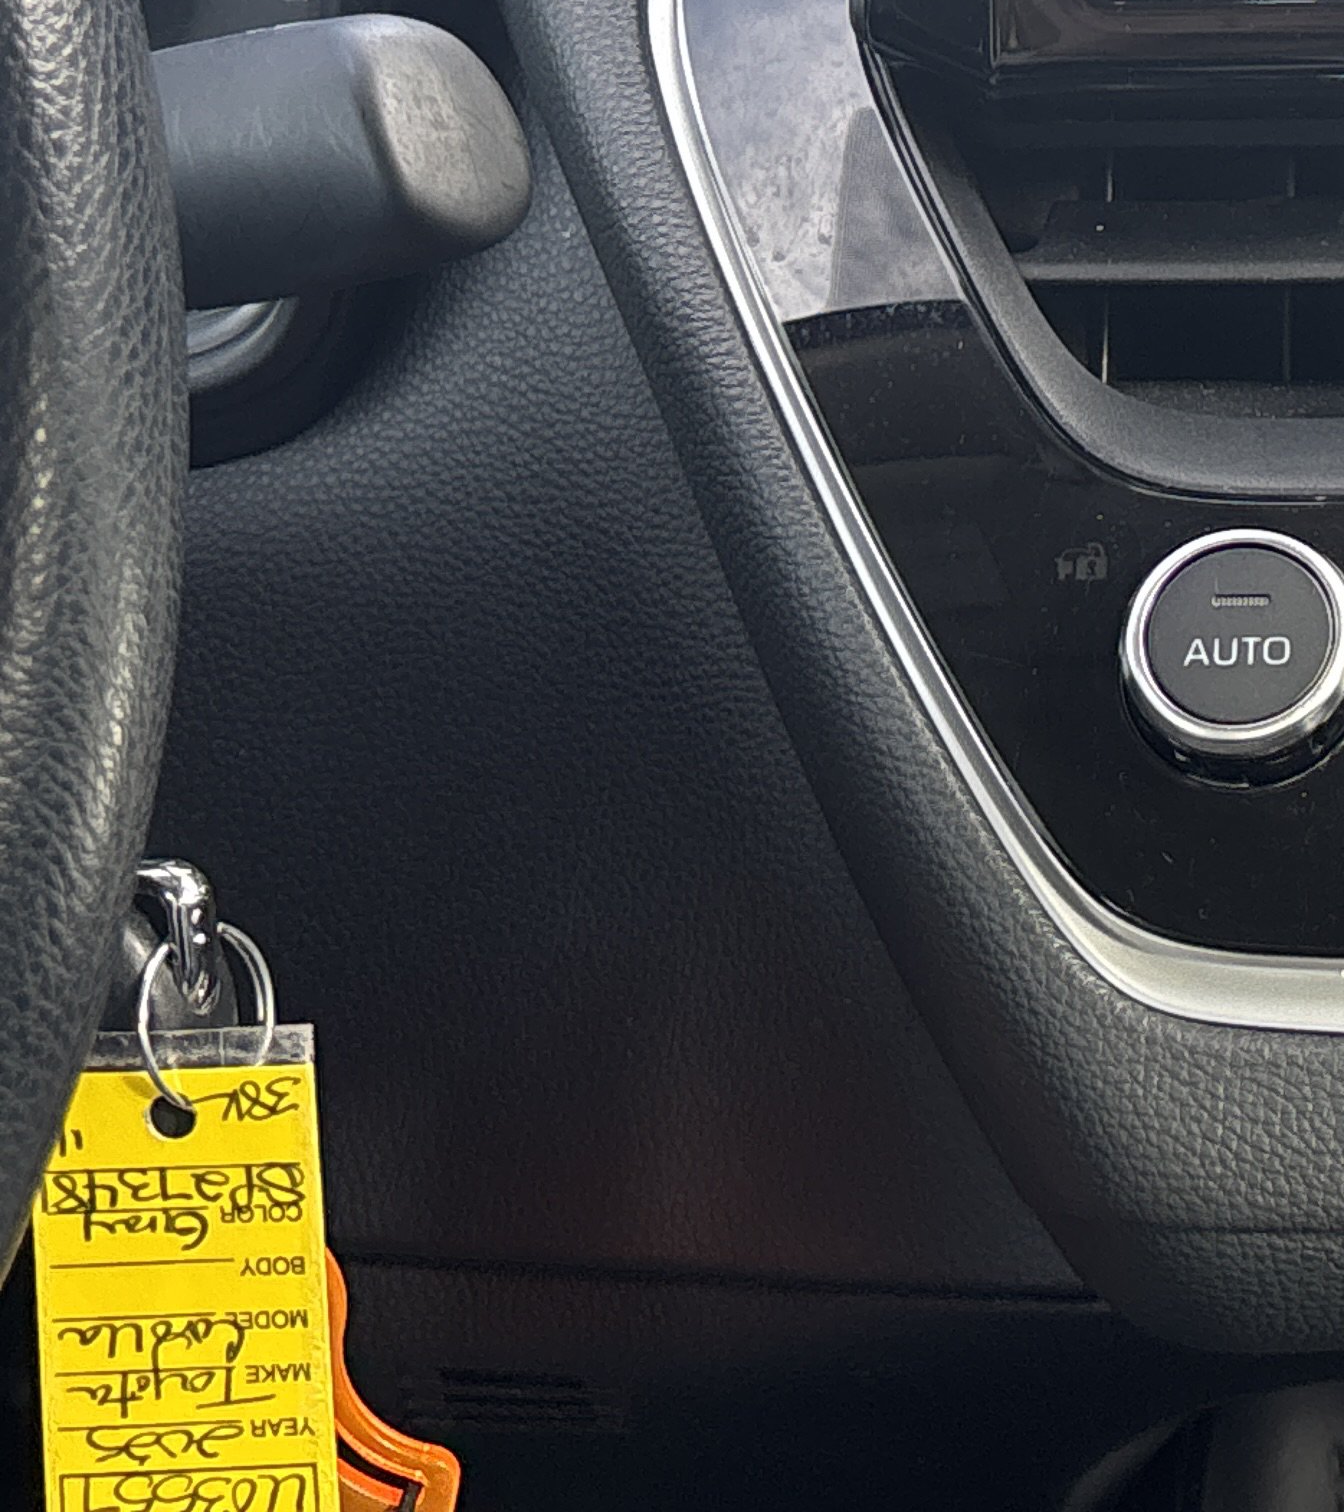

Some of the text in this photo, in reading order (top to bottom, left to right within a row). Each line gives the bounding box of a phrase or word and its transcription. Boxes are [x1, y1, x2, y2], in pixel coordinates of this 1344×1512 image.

[1183, 635, 1292, 667] AUTO
[83, 1203, 303, 1252] COLOR Gray
[239, 1255, 307, 1276] BODY
[225, 1308, 309, 1330] MODEL
[66, 1362, 311, 1419] MAKE Toyota
[250, 1417, 316, 1438] YEAR
